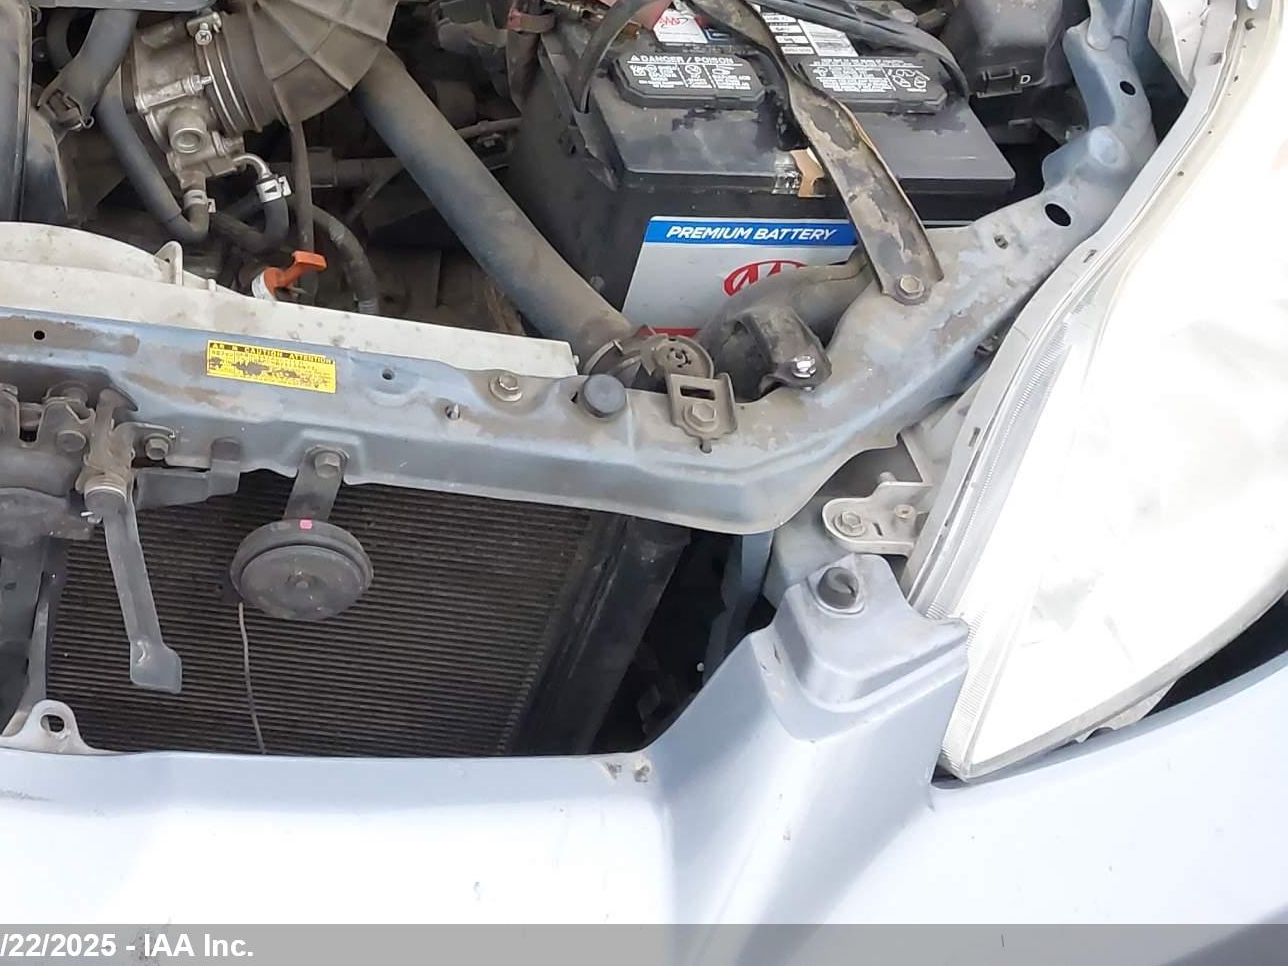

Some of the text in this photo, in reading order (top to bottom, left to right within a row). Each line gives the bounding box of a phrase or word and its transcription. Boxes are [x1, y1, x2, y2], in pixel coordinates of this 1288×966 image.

[640, 54, 684, 64] DANGER
[694, 56, 734, 65] POISON
[1019, 74, 1031, 85] D
[666, 225, 837, 241] PREMIUM BATTERY
[244, 347, 283, 358] CAUTION
